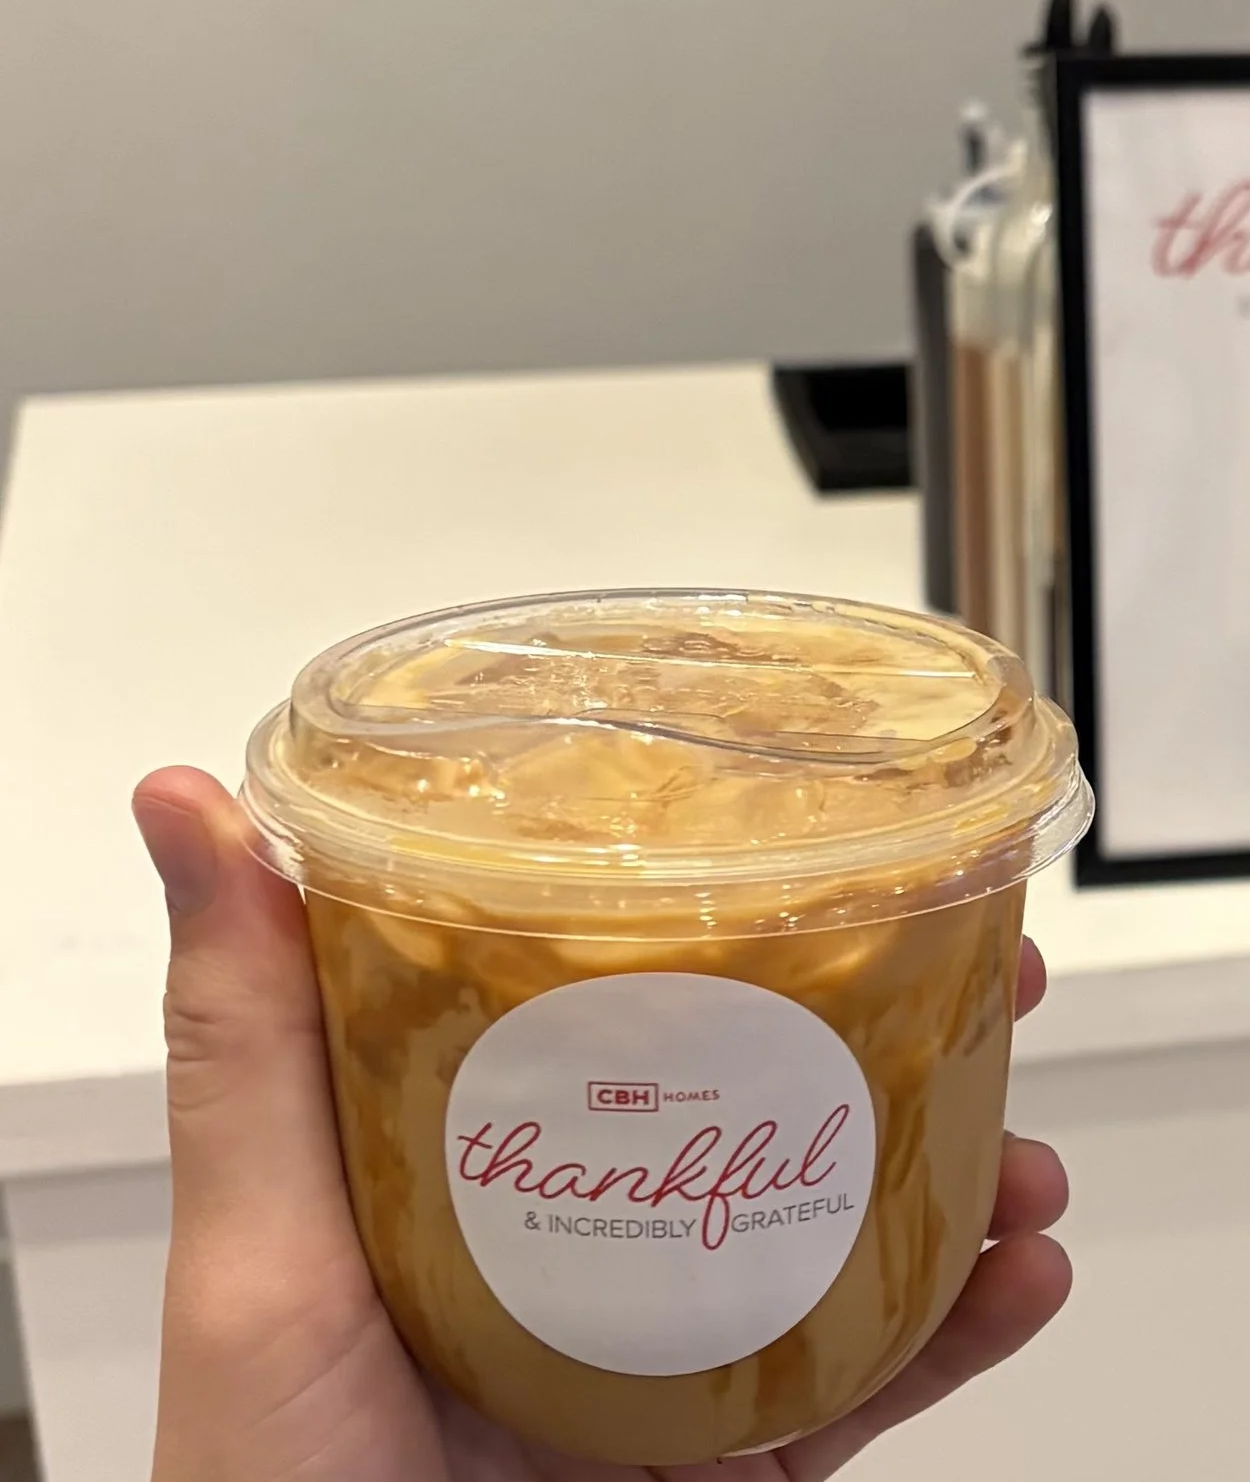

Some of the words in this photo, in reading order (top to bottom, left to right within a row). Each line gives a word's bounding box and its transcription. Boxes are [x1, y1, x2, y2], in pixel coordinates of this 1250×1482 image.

[596, 1086, 651, 1106] CBH
[662, 1088, 721, 1103] HOMES
[457, 1103, 850, 1251] thankful
[524, 1211, 541, 1232] &
[547, 1213, 698, 1241] INCREDIBLY
[731, 1192, 856, 1234] GRATEFUL
